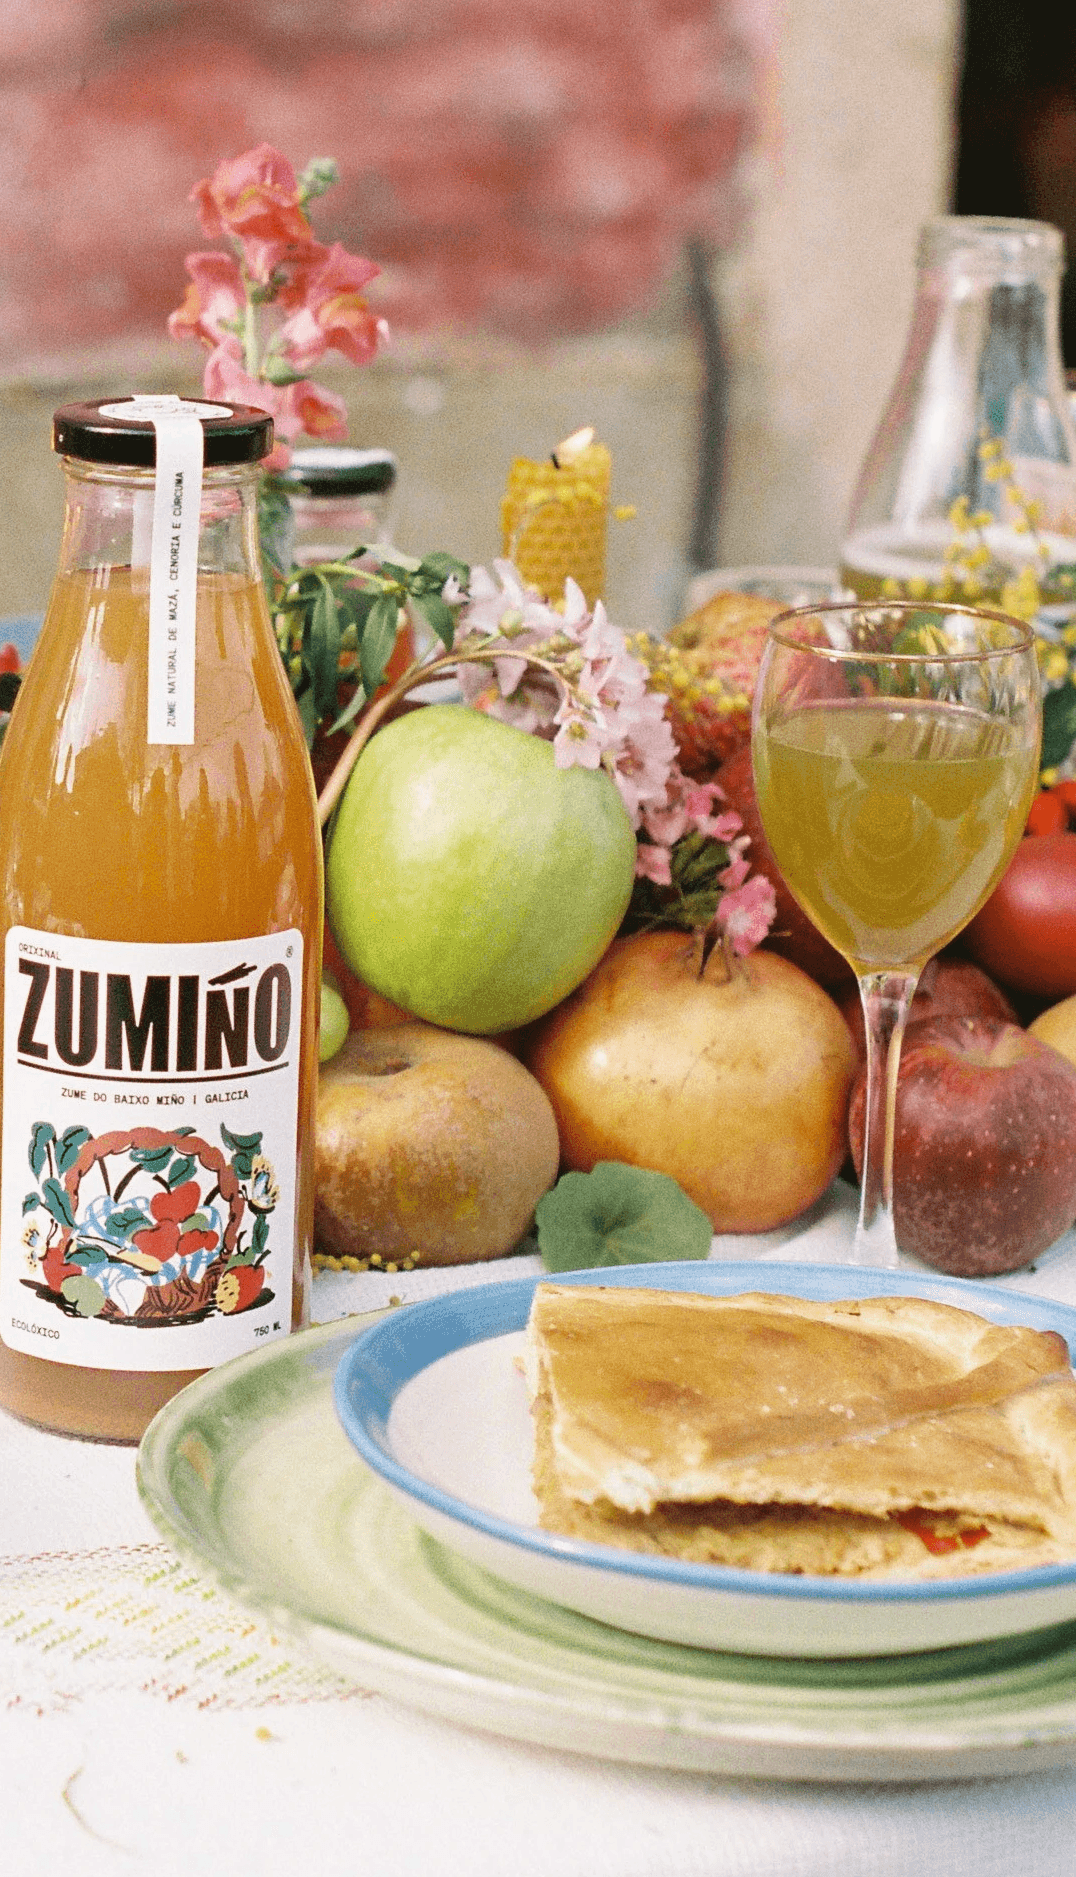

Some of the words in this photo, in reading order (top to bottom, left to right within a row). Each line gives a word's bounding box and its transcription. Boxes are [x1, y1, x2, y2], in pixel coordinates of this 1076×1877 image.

[169, 535, 181, 581] CENORIA
[168, 627, 178, 641] DE
[167, 649, 177, 694] NATURAL
[166, 701, 176, 728] ZUME
[18, 942, 62, 961] ORIXINAL
[17, 957, 292, 1072] ZUMIÑO
[61, 1087, 86, 1100] ZUME
[93, 1092, 107, 1102] DO
[114, 1094, 149, 1105] BAIXO
[156, 1093, 185, 1105] MIÑO
[205, 1089, 249, 1104] GALICIA
[11, 1317, 60, 1340] ECOLÓXICO
[253, 1324, 270, 1337] 750
